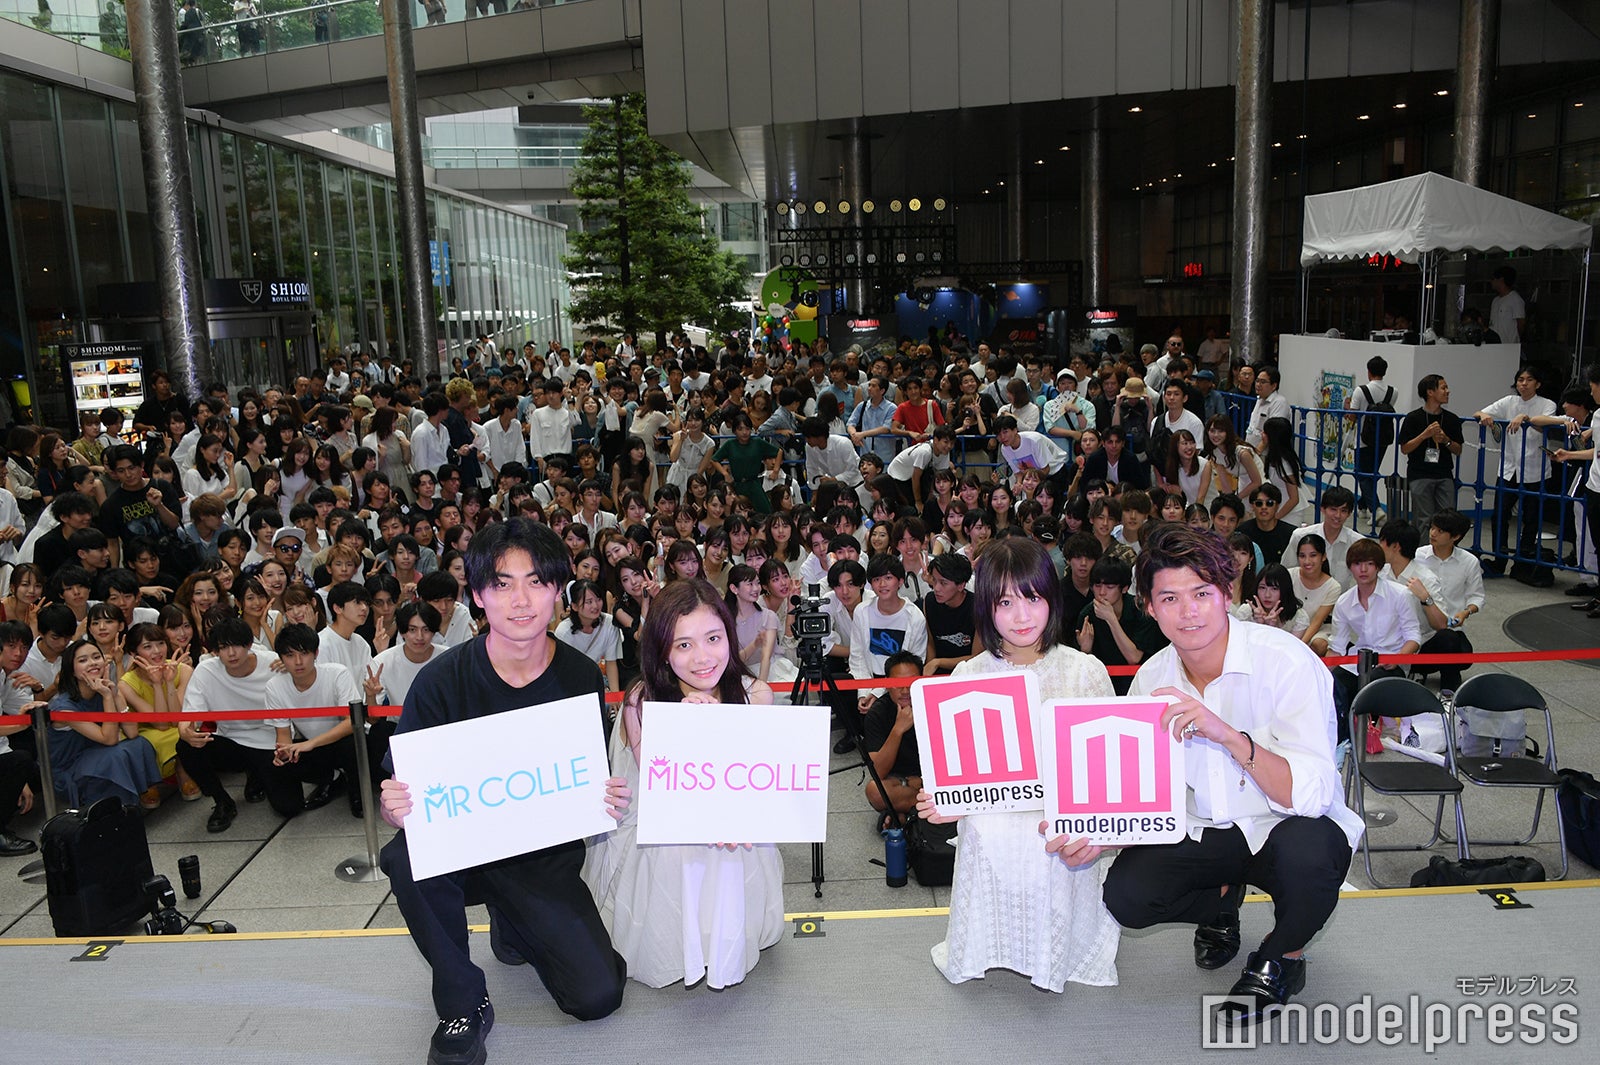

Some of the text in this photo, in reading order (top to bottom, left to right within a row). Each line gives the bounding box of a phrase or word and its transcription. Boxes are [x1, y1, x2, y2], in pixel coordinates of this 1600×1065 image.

[81, 345, 127, 354] SHIODOME
[648, 756, 821, 791] MISS COLLE
[424, 756, 590, 823] MR COLLE
[934, 784, 1044, 806] modelpress
[1055, 815, 1176, 836] modelpress
[1495, 893, 1516, 904] 2
[86, 945, 107, 957] 2
